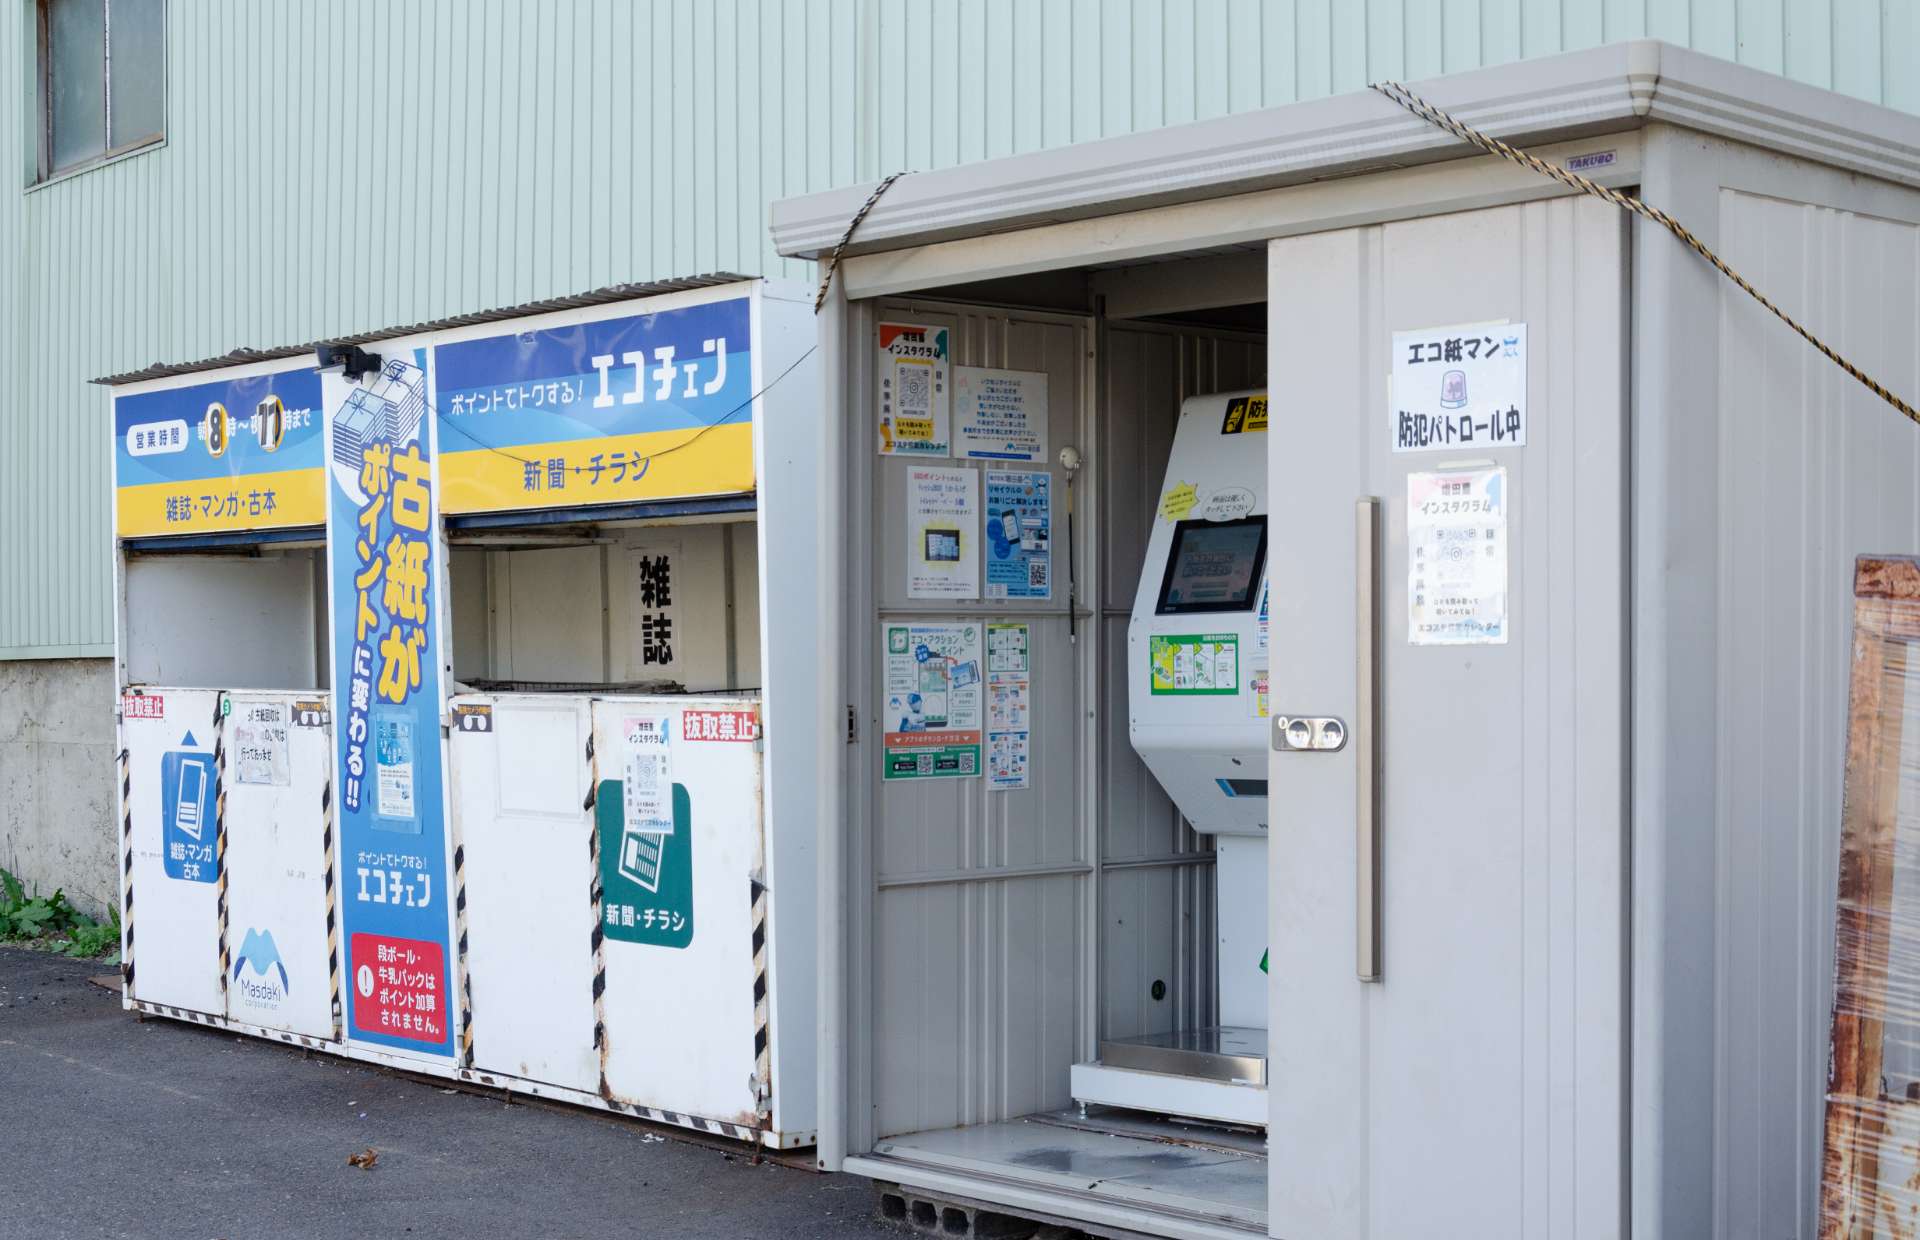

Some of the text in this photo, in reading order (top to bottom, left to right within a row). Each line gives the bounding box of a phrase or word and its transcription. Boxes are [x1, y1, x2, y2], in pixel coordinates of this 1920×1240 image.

[1568, 153, 1614, 170] TAKUBO
[1408, 337, 1500, 365] エコ紙マン
[591, 337, 727, 409] エコチェン
[135, 426, 181, 450] 営業時間
[1398, 404, 1521, 449] 防犯パトロール中
[524, 451, 651, 491] 新聞・チラシ
[165, 488, 277, 522] 雑誌・マンガ・古本
[378, 445, 431, 704] 古紙が
[639, 555, 673, 665] 雑誌
[685, 712, 753, 740] 抜取禁止
[183, 863, 201, 881] 古本
[357, 867, 431, 908] エコチェン
[605, 904, 686, 932] 新聞・チラシ
[241, 977, 281, 1002] Masdaki
[378, 967, 436, 990] 牛乳パックは
[379, 989, 436, 1013] ポイント加算
[381, 1009, 440, 1035] されません。
